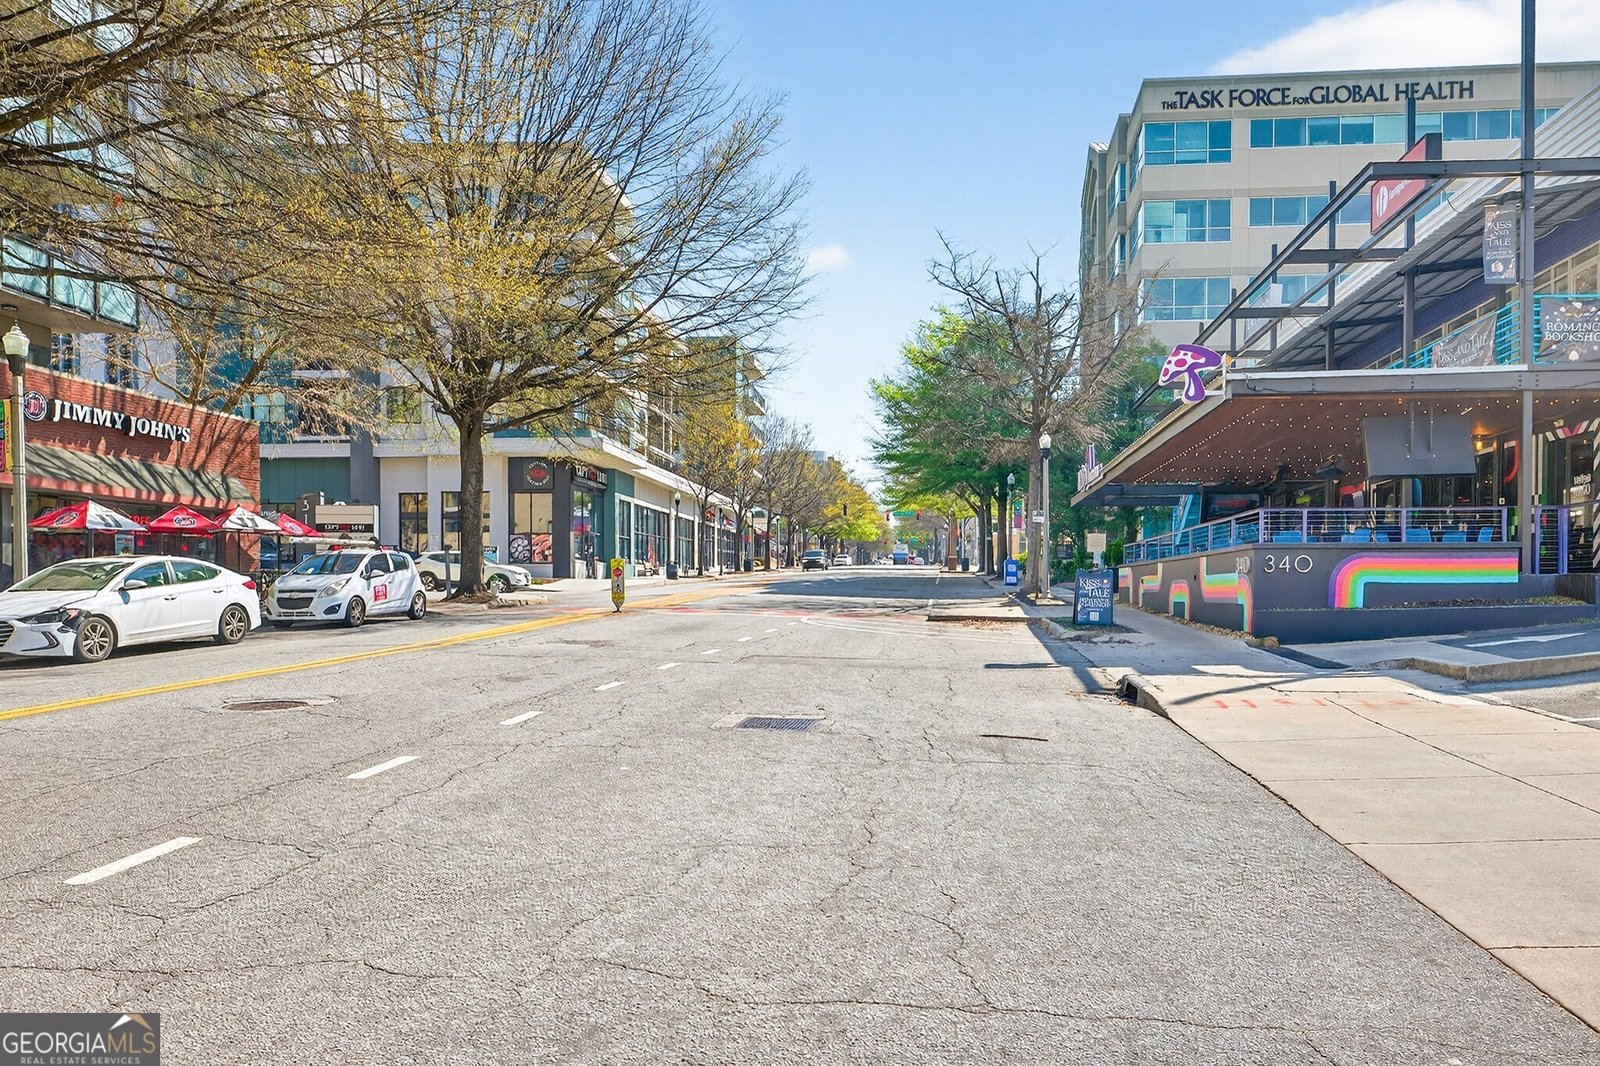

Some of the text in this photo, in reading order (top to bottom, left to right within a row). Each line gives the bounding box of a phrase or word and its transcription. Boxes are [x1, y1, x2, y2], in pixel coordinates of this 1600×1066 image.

[1162, 80, 1474, 110] THE TASK FORCE FOR GLOBAL HEALTH
[53, 400, 191, 443] JIMMY JOHN'S
[1235, 555, 1251, 574] 340
[1264, 554, 1313, 573] 340
[1080, 578, 1101, 590] KISS
[1088, 588, 1111, 598] TALE
